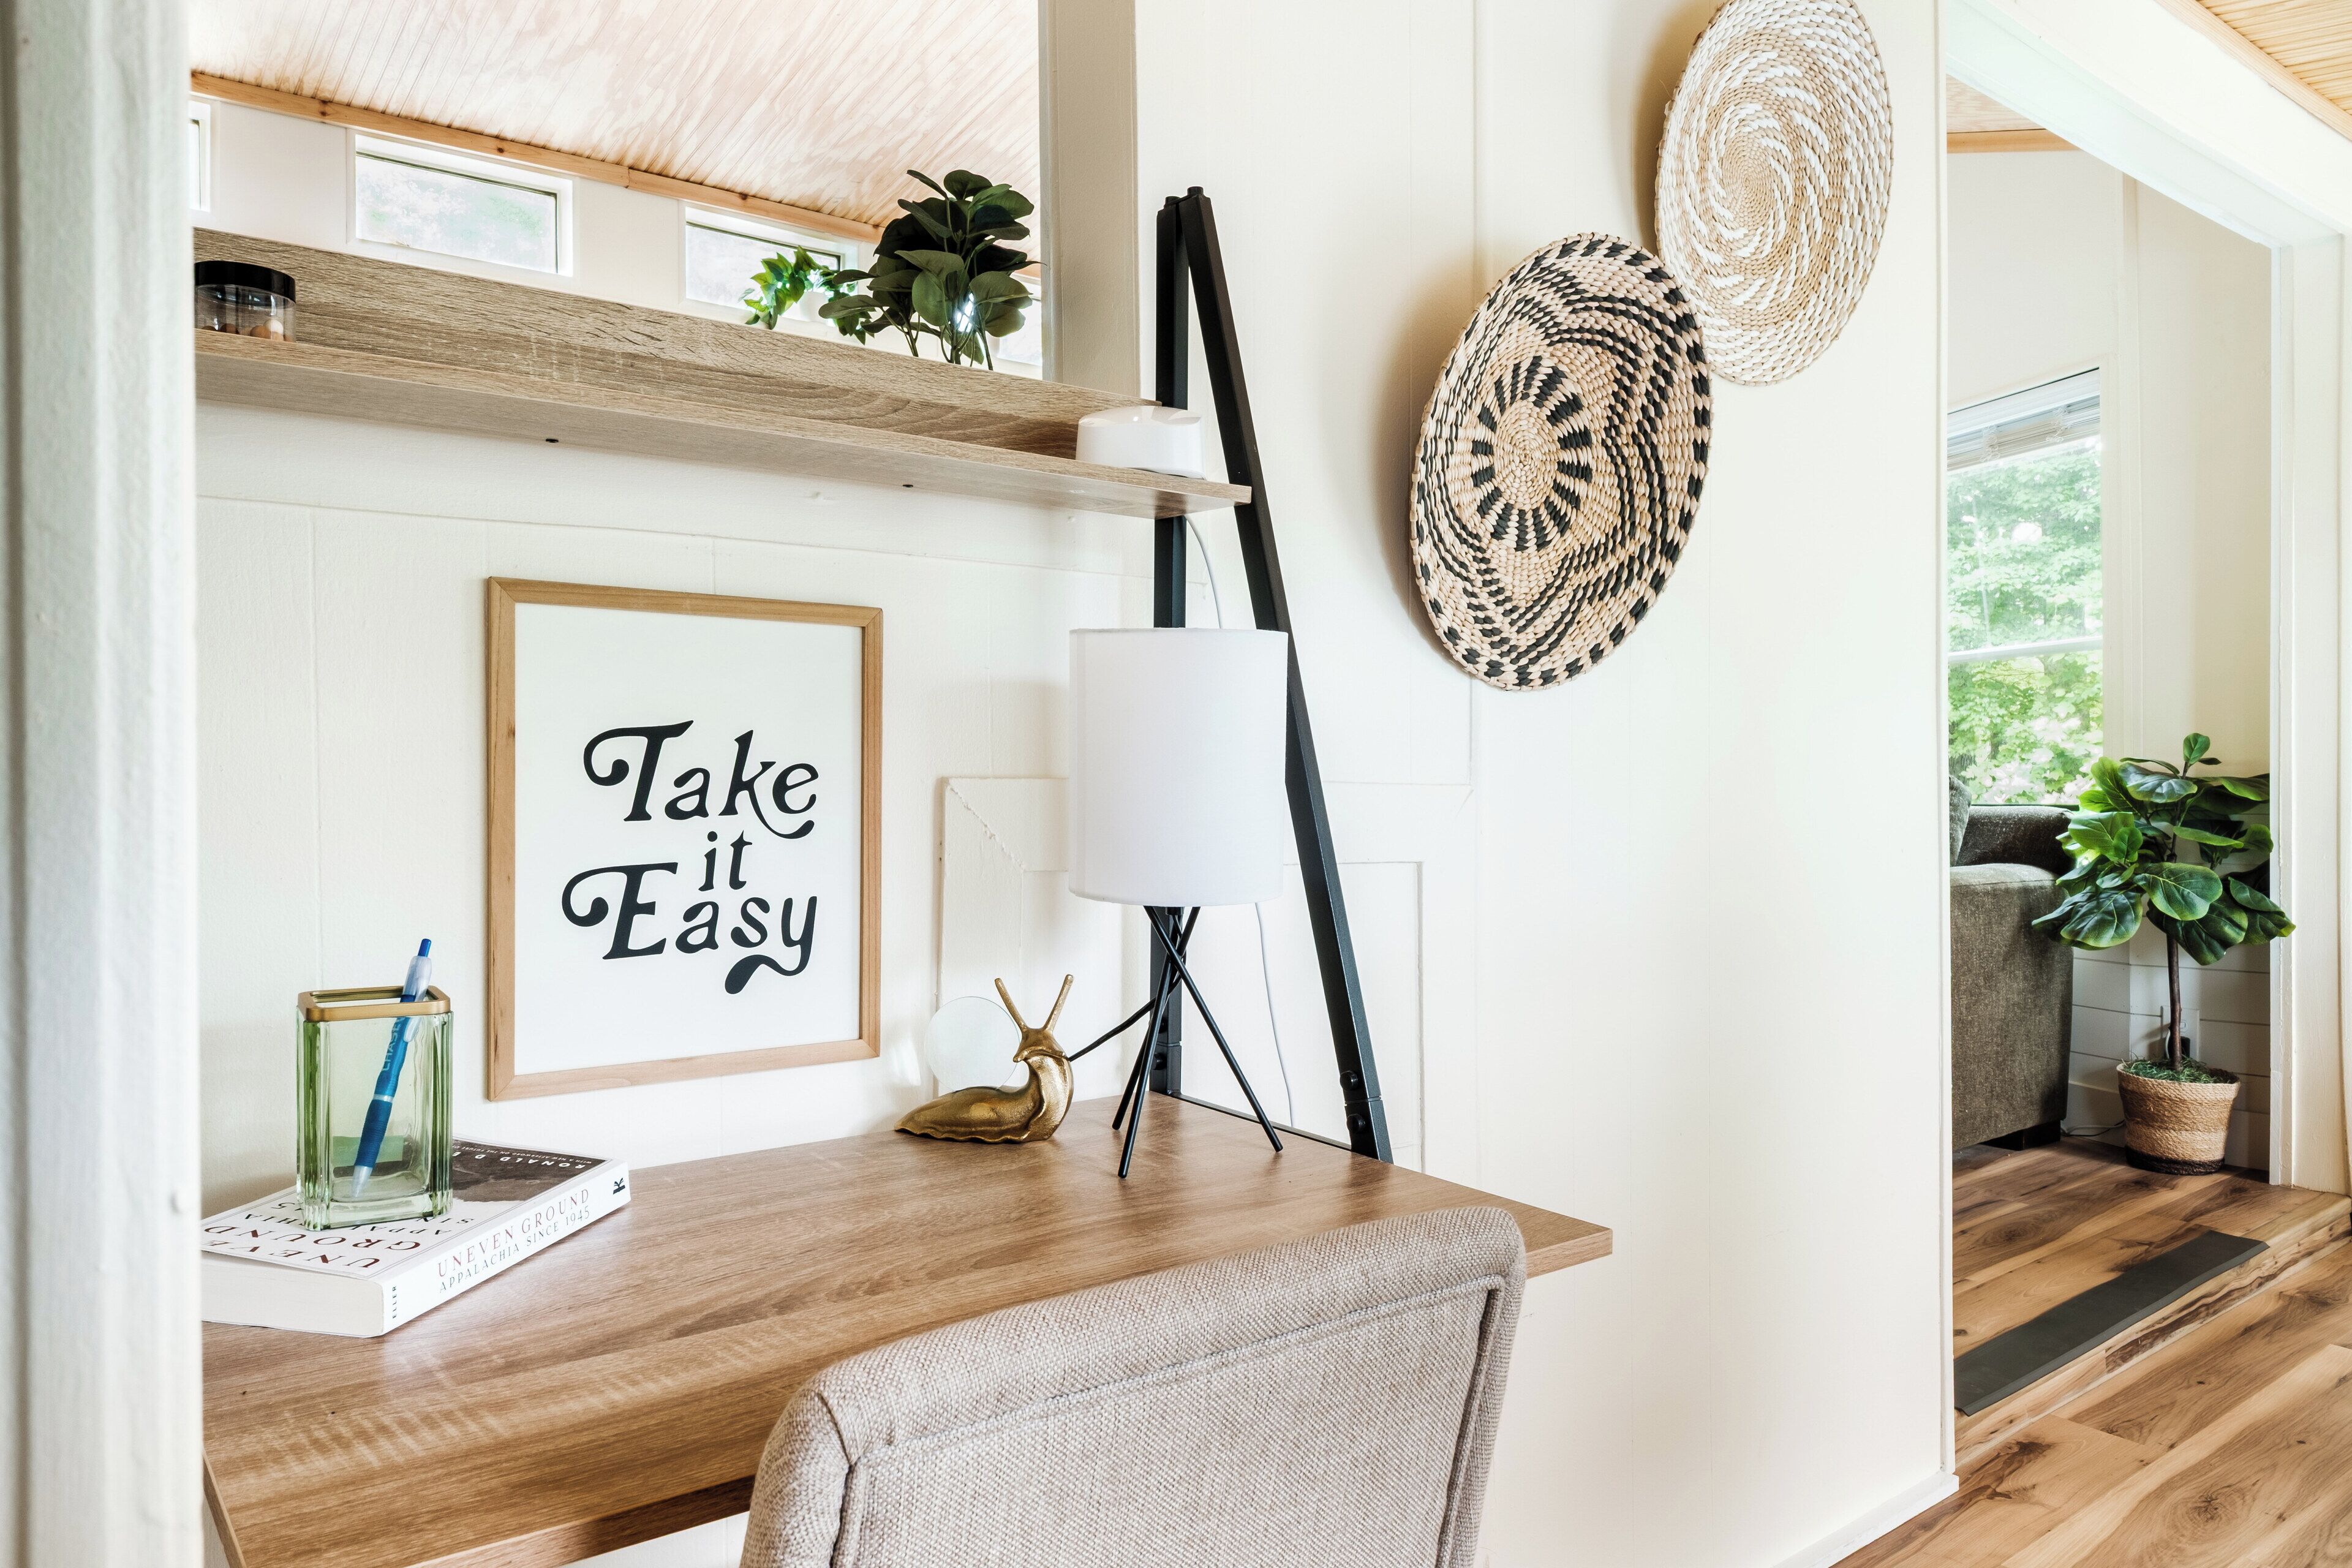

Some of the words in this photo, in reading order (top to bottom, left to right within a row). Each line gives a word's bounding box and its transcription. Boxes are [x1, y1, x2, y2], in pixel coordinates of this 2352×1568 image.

[584, 720, 819, 839] Take
[698, 830, 753, 892] it
[562, 862, 818, 995] Easy
[500, 1156, 586, 1169] RONALD
[202, 1240, 380, 1268] UNEVE
[204, 1226, 421, 1250] GROUND
[437, 1226, 514, 1277] UNEVEN
[521, 1188, 589, 1234] GROUND
[439, 1243, 519, 1294] APPALACHIA
[526, 1221, 559, 1246] SINCE
[565, 1205, 590, 1226] 1945
